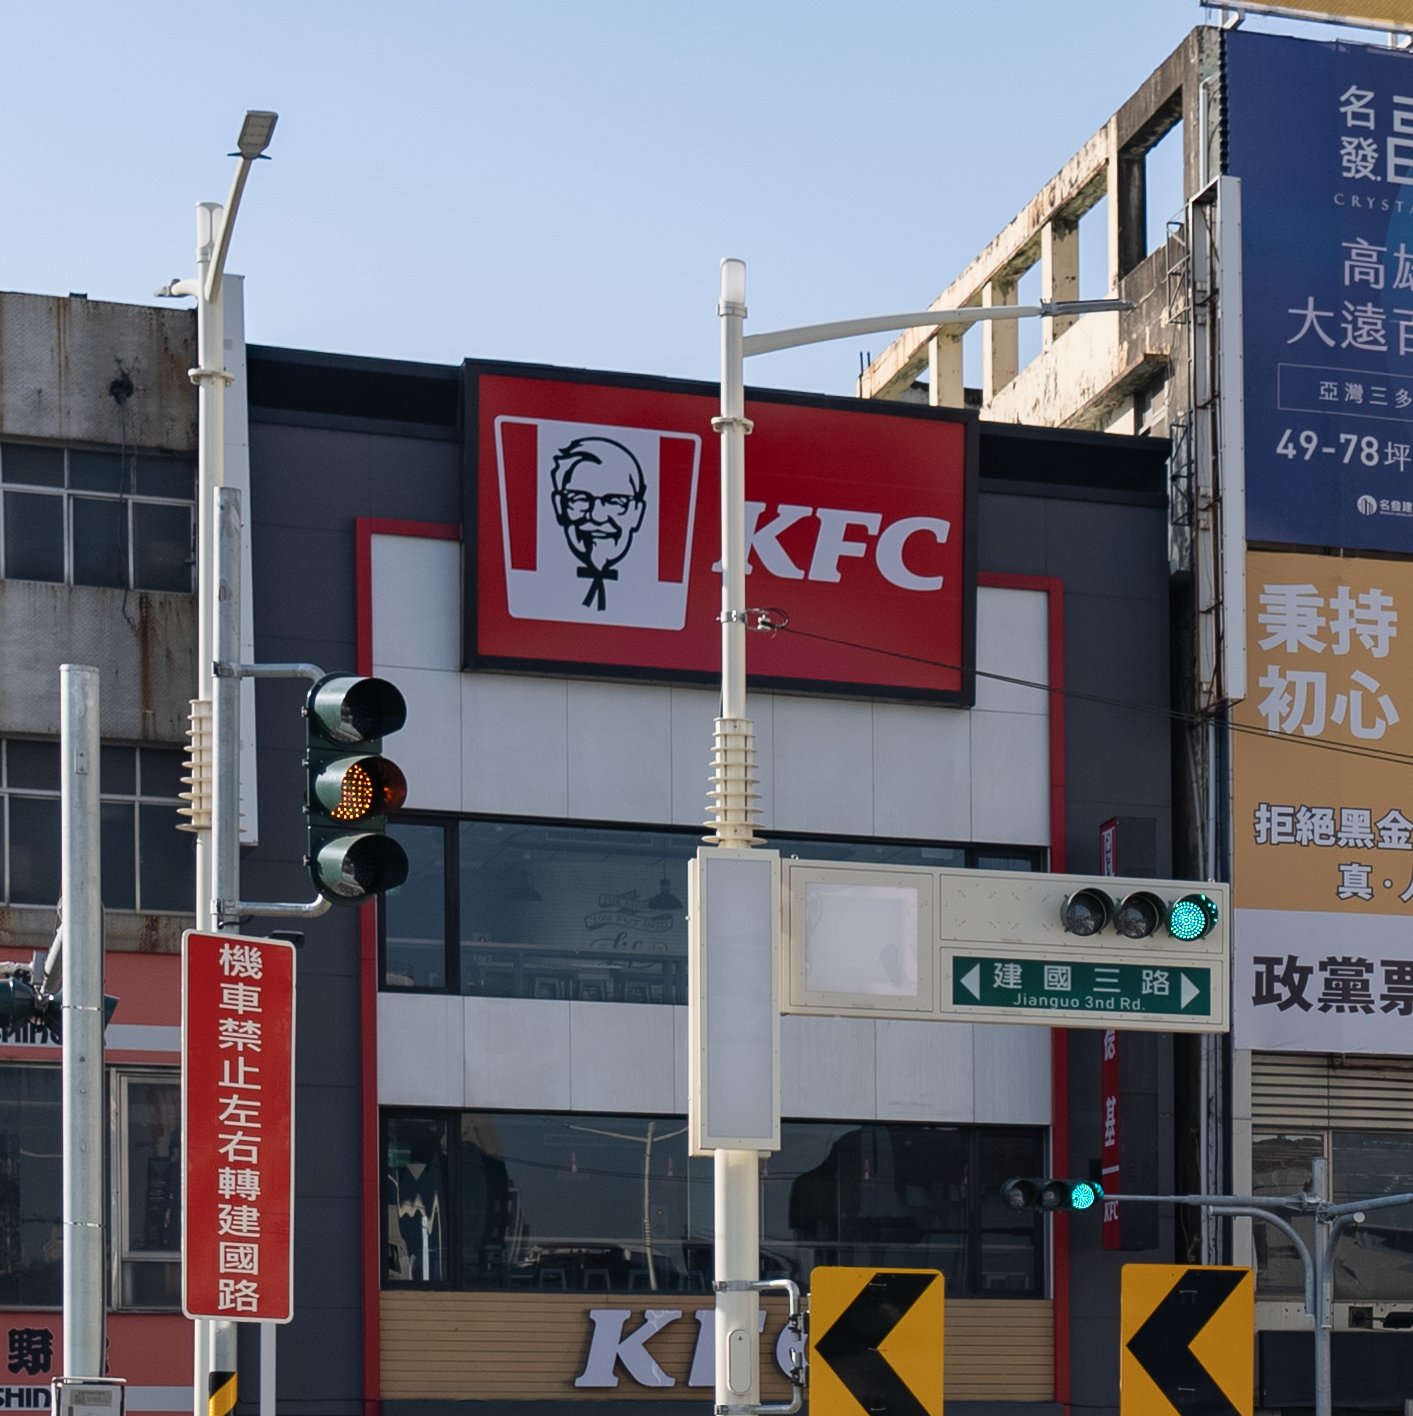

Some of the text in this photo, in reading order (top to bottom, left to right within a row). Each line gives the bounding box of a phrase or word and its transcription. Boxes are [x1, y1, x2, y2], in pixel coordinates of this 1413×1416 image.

[1276, 428, 1412, 472] 49-78坪
[712, 500, 952, 593] KFC
[1256, 583, 1399, 659] 秉持
[1256, 664, 1400, 741] 初心
[993, 961, 1171, 997] 建國三路
[1012, 992, 1147, 1012] Jianguo 3nd Rd.
[217, 942, 264, 1313] 機車禁止左右轉建國路
